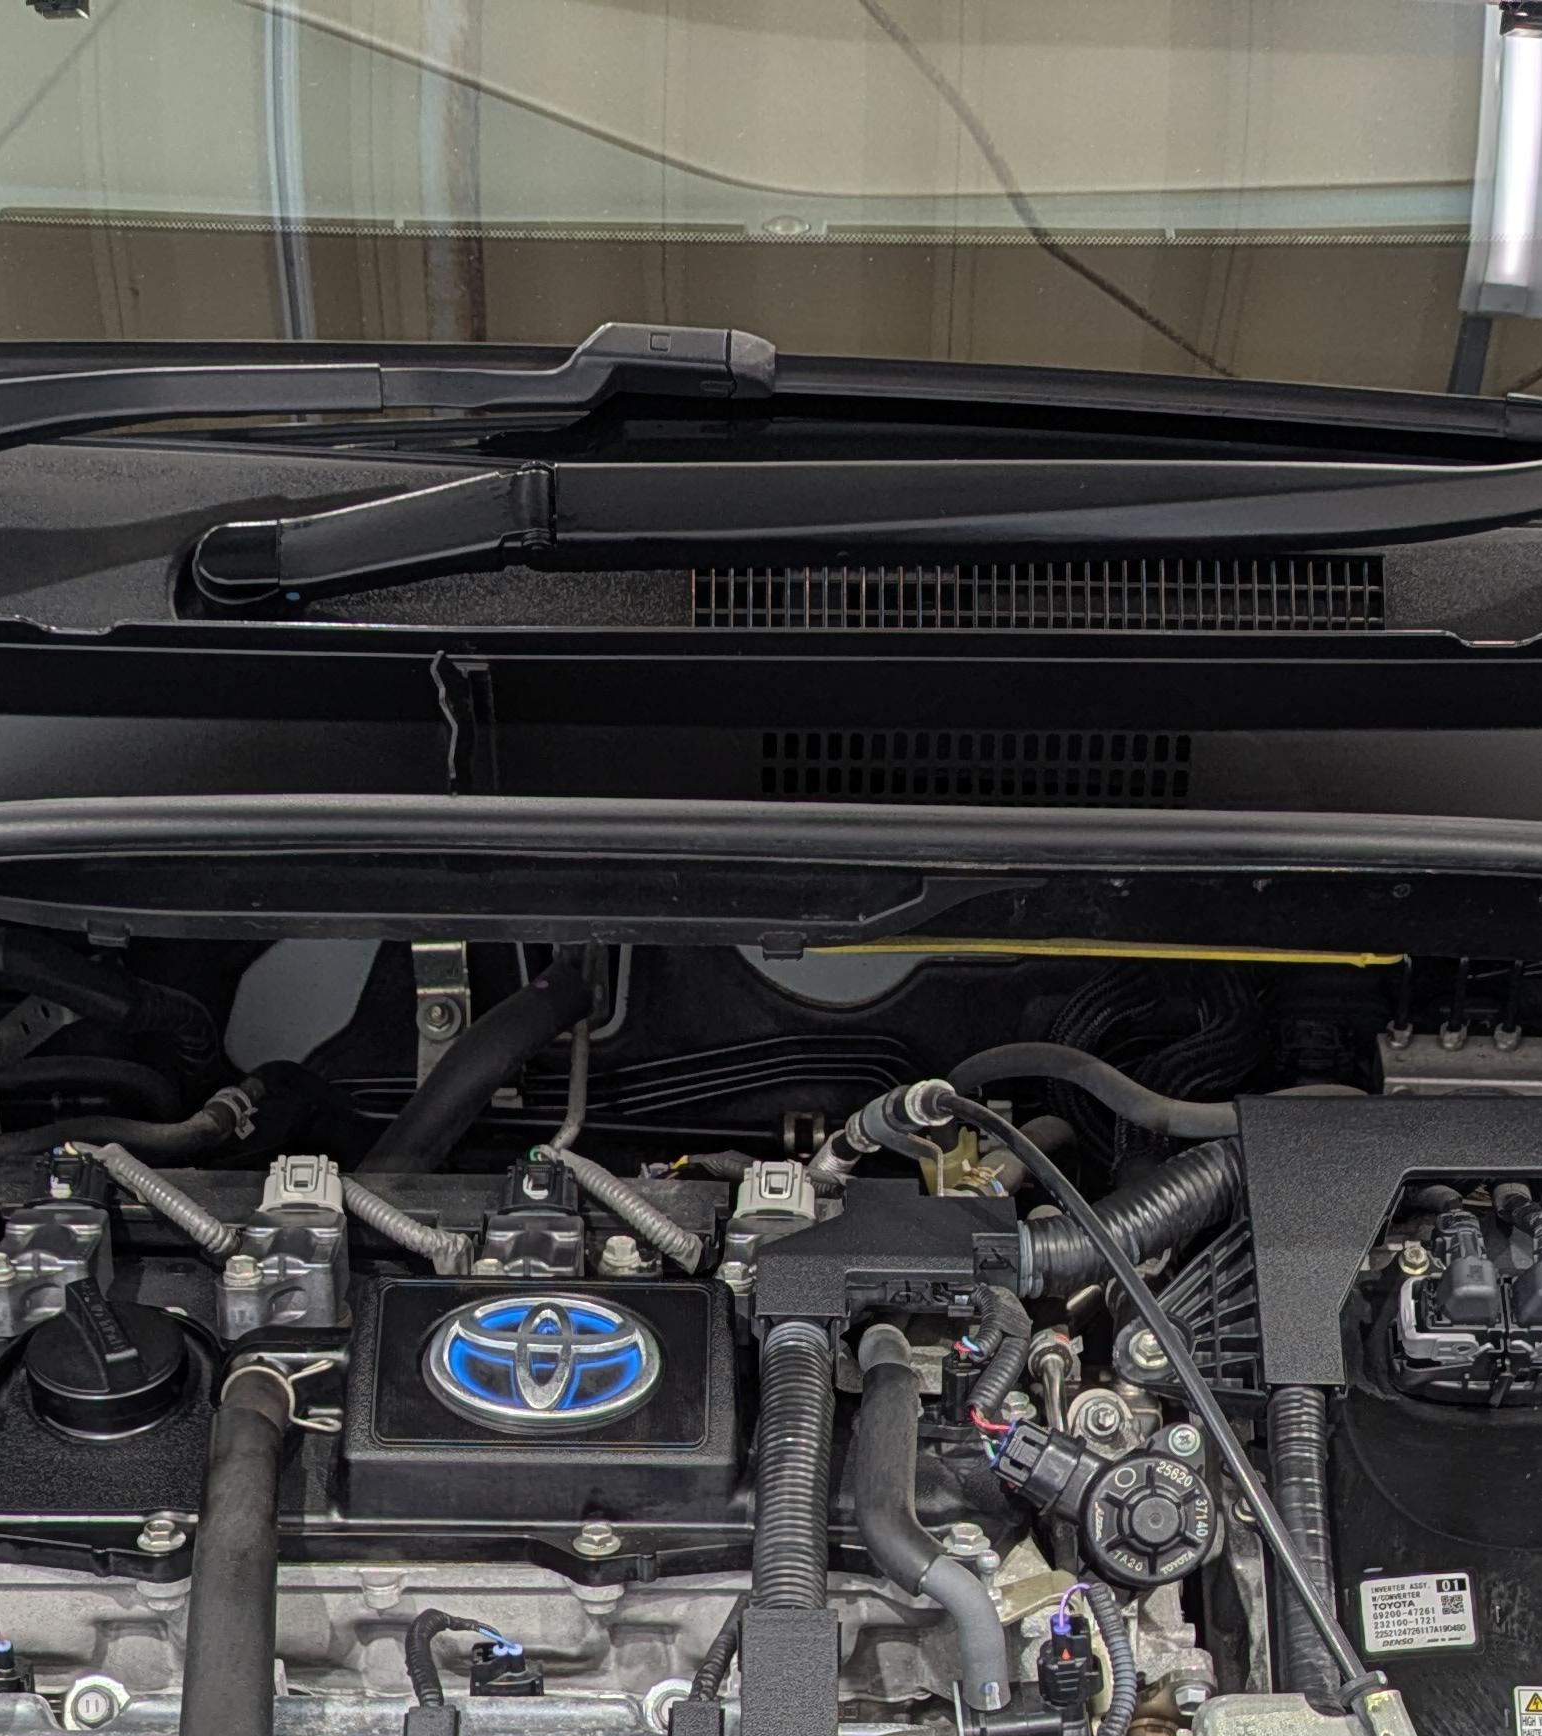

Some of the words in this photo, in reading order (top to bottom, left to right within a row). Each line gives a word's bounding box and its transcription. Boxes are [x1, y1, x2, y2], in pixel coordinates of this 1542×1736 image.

[1156, 1461, 1193, 1487] 25620
[1194, 1498, 1209, 1537] 37140
[1160, 1550, 1196, 1575] TOYOTA
[1371, 1584, 1406, 1594] INVERTER
[1441, 1580, 1459, 1591] 01
[1372, 1600, 1415, 1610] TOYOTA
[1374, 1617, 1436, 1629] 232100-1721
[1382, 1637, 1414, 1647] DENSO
